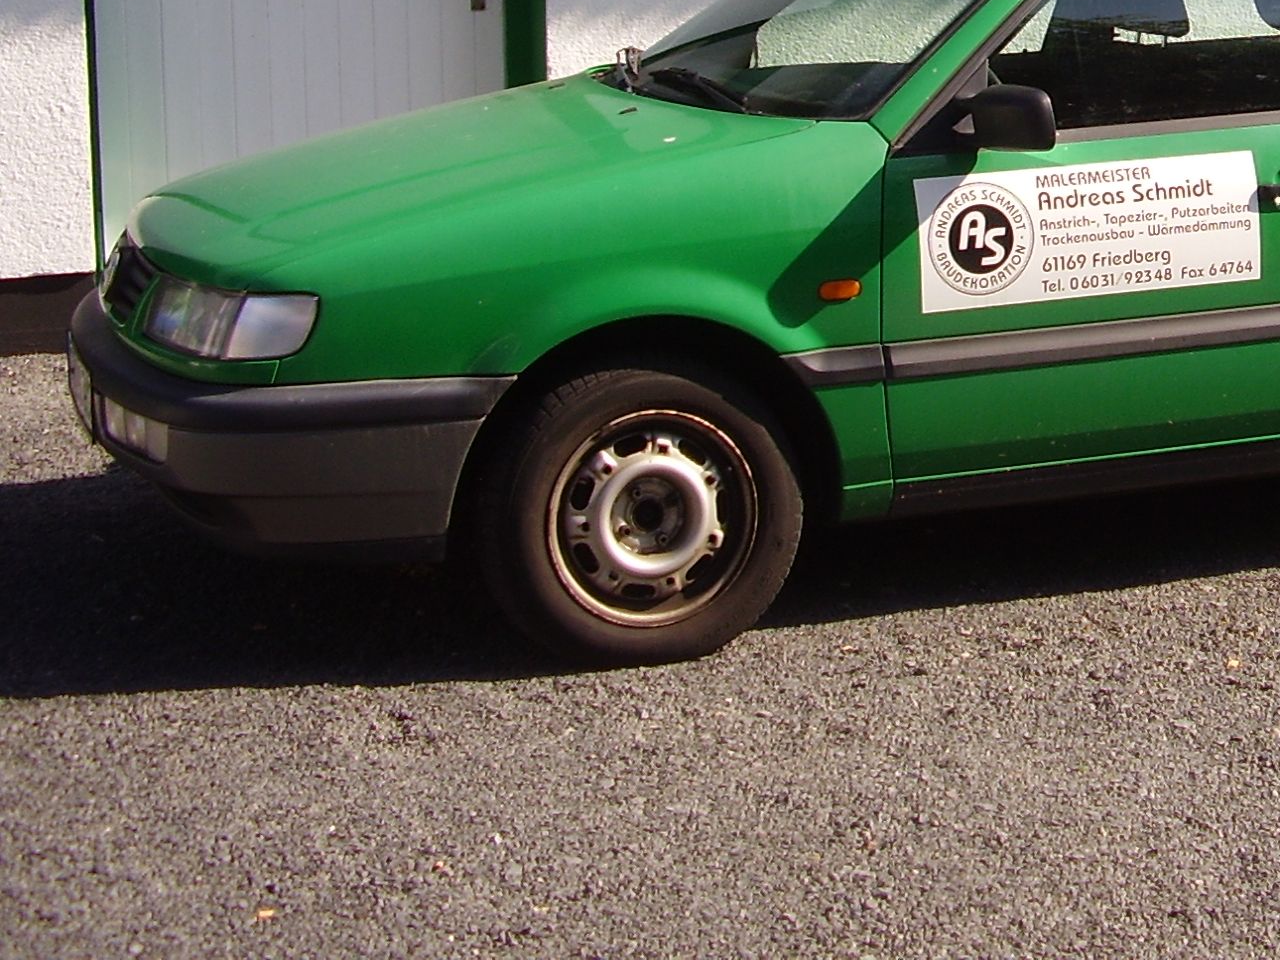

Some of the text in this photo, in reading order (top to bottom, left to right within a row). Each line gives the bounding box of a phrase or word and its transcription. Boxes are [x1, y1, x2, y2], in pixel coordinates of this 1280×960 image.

[1035, 166, 1151, 189] MALERMEISTER
[1038, 178, 1214, 211] Andreas Schmidt
[935, 189, 1027, 240] ANDREAS SCHMIDT
[1039, 202, 1250, 232] Anstrich-, Tapezier-, Putzarbeiten
[957, 209, 1007, 267] AS
[1039, 230, 1135, 247] Trockenausbau
[1147, 217, 1252, 238] Wärmedämmung
[936, 243, 1027, 290] BAUDEKORATION
[1041, 280, 1065, 294] Tel.
[1180, 266, 1205, 280] Fax
[1208, 259, 1253, 277] 64764
[1042, 248, 1171, 273] 61169 Friedberg
